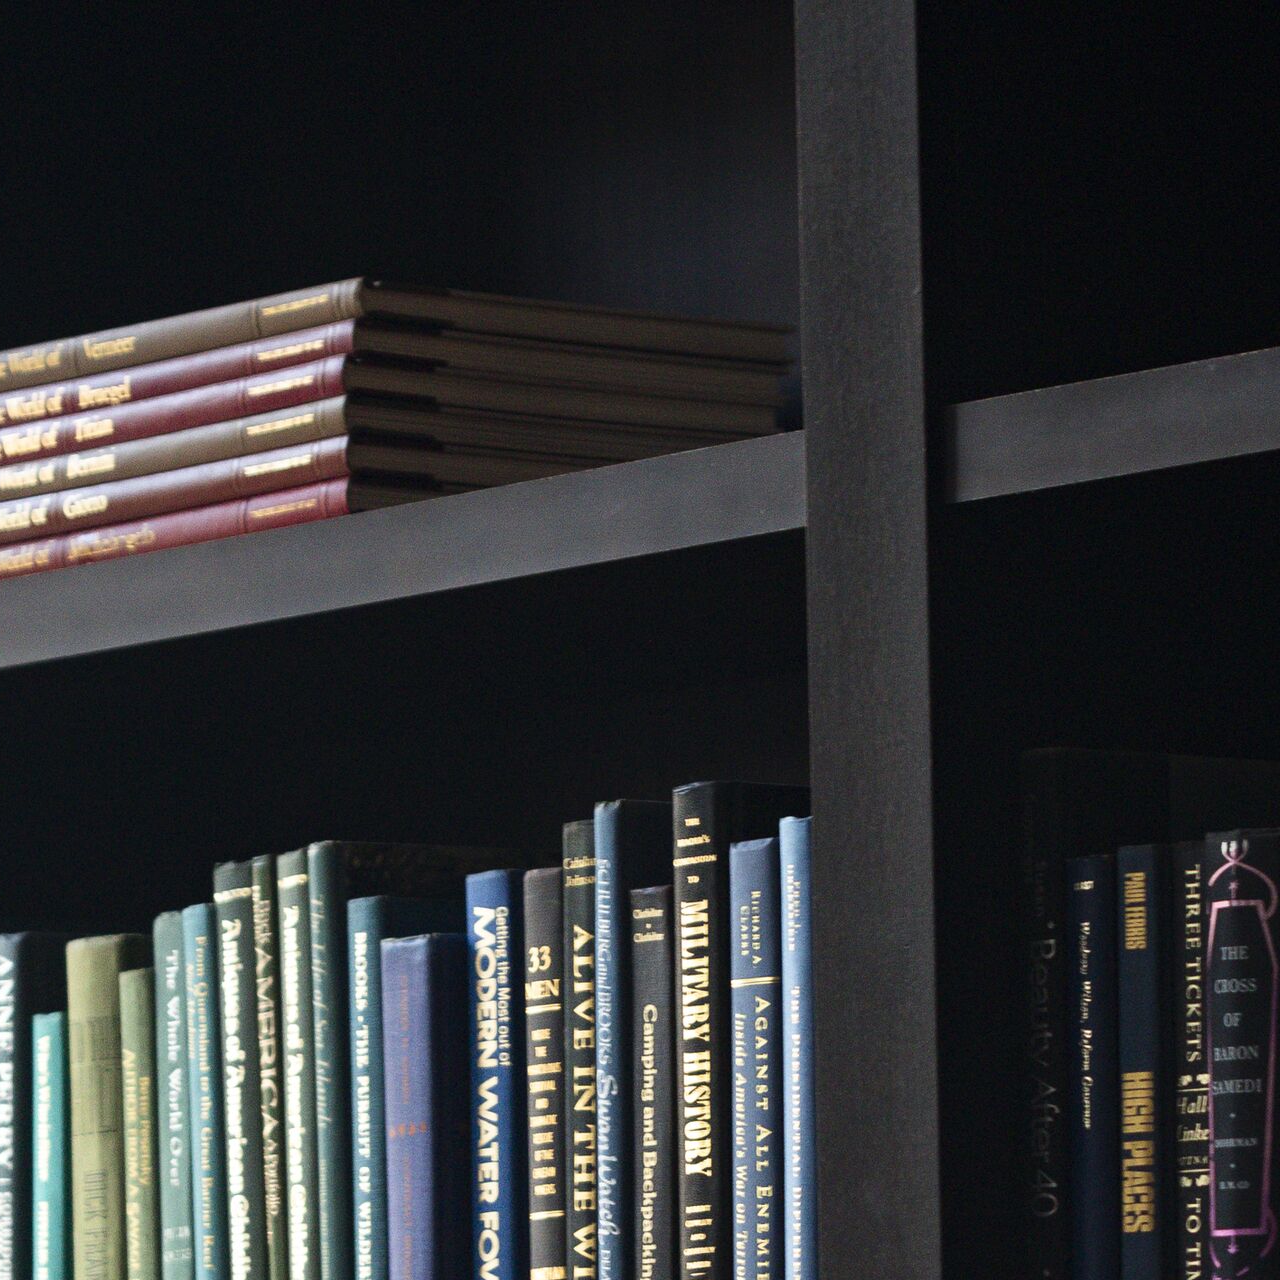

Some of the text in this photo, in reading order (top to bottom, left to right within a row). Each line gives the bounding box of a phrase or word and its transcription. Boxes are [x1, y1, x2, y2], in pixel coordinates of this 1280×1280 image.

[1124, 872, 1147, 903] PAUL
[1185, 865, 1201, 949] THREE
[354, 932, 367, 1010] BROOKS
[474, 908, 496, 1068] MODERN
[493, 907, 510, 1066] Getting the Most out of
[529, 945, 551, 972] 33
[572, 924, 595, 1051] ALIVE
[680, 900, 711, 1041] MILITARY
[1221, 946, 1250, 959] THE
[356, 1025, 368, 1069] THE
[735, 1013, 748, 1068] Inside
[792, 987, 800, 1027] THE
[1186, 958, 1201, 1063] TICKETS
[1223, 1013, 1243, 1027] OF
[573, 1067, 595, 1110] IN
[640, 1004, 658, 1100] Camping
[755, 997, 770, 1108] AGAINST
[1032, 939, 1060, 1217] Beauty After 40
[357, 1076, 369, 1157] PURSUIT
[478, 1078, 498, 1203] WATER
[642, 1107, 657, 1145] and
[682, 1052, 712, 1177] HISTORY
[792, 1033, 802, 1178] PRESIDENTIAL
[358, 1167, 370, 1192] OF
[573, 1125, 595, 1211] THE
[735, 1165, 748, 1197] War
[756, 1126, 772, 1171] ALL
[1121, 1072, 1155, 1233] HIGH PLACES
[599, 1153, 619, 1244] Watch
[736, 1203, 746, 1222] on
[1186, 1199, 1201, 1233] TO
